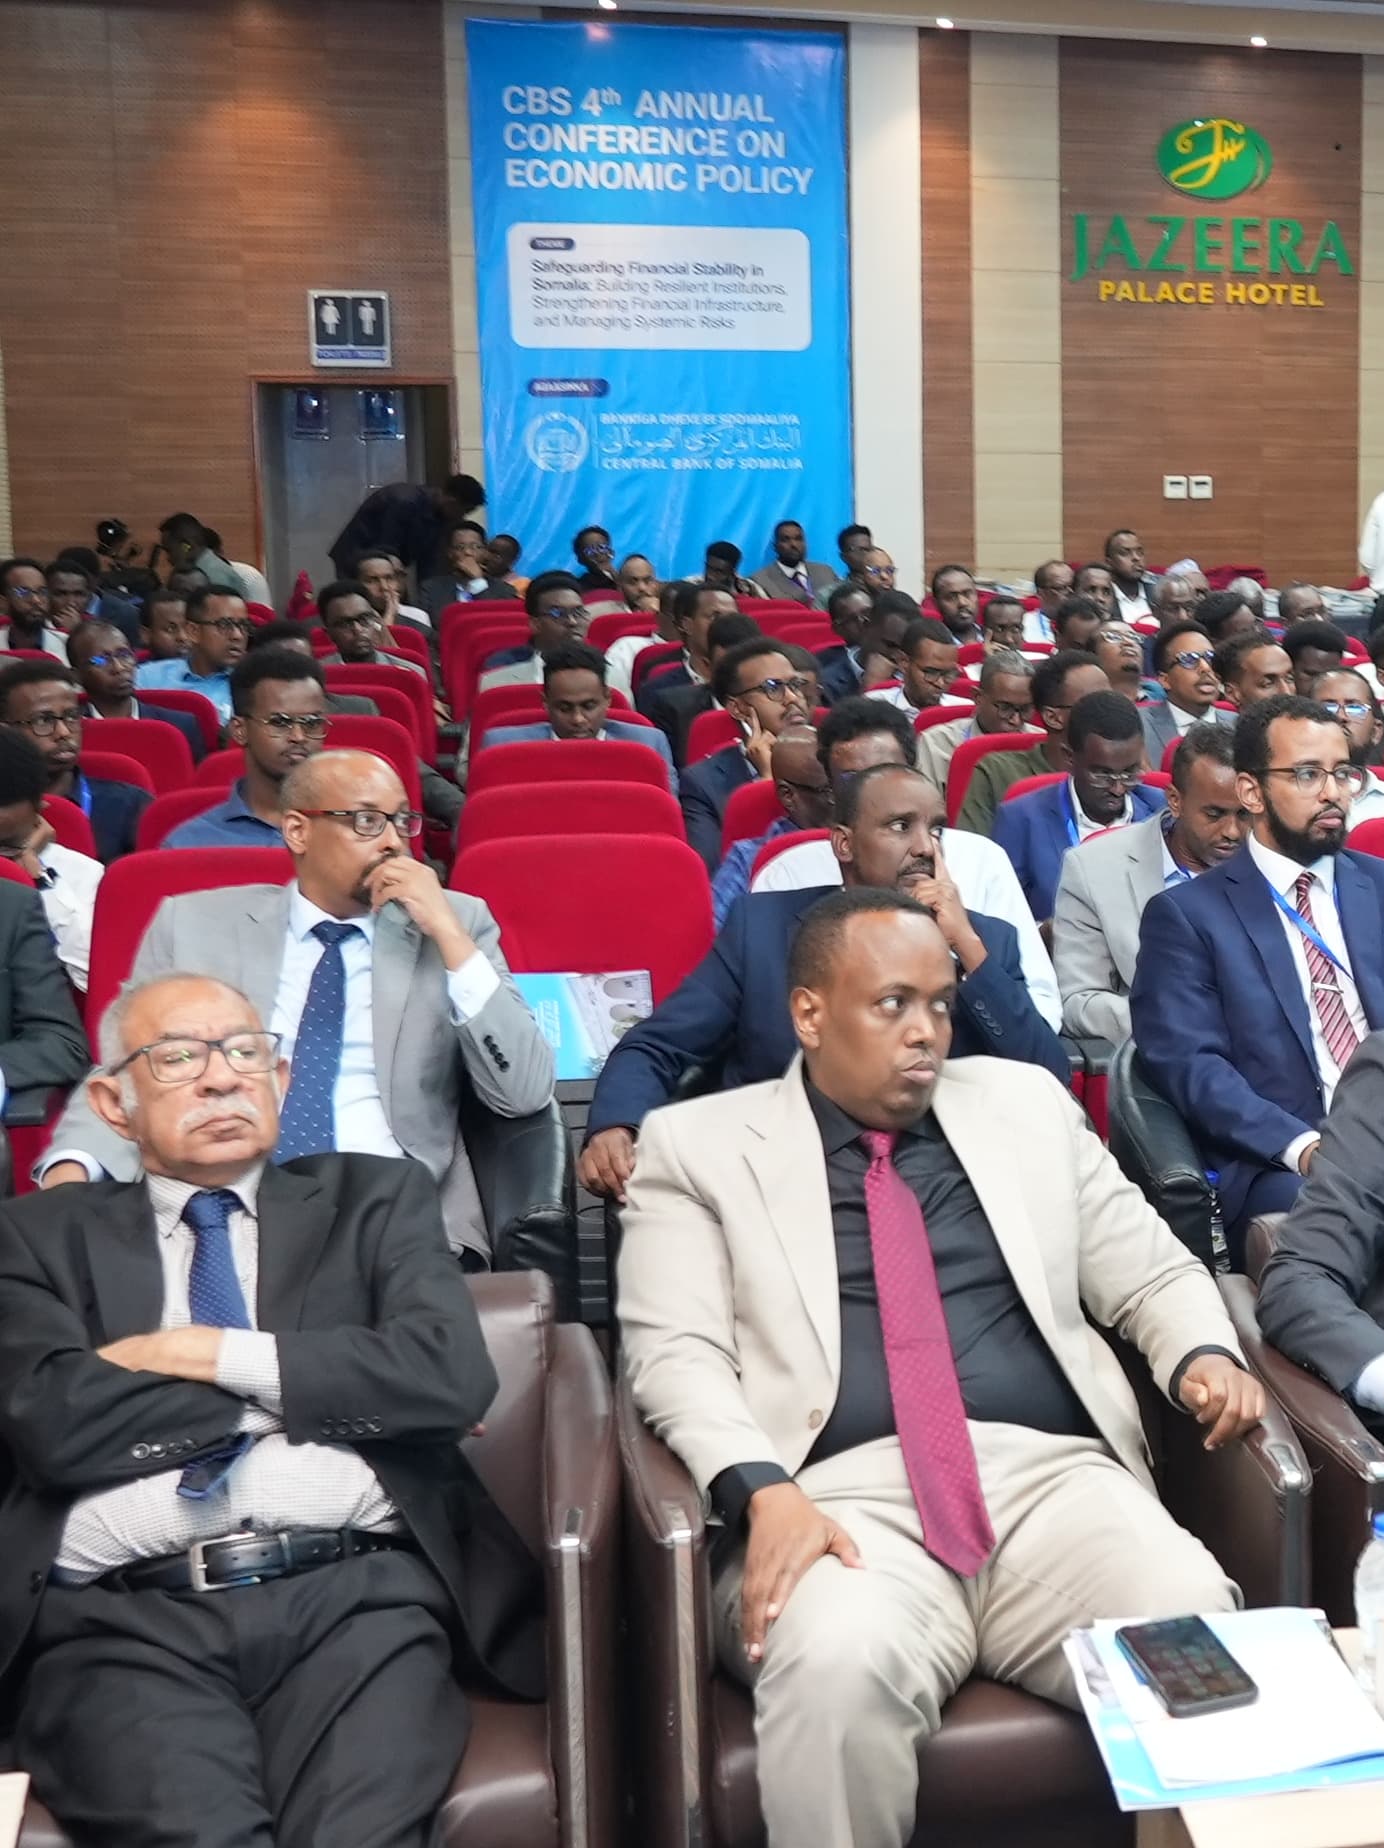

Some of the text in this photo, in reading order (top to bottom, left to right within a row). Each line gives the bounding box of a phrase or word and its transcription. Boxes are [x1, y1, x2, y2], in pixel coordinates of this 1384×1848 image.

[502, 85, 775, 124] CBS 4th ANNUAL
[503, 121, 786, 159] CONFERENCE ON
[505, 158, 815, 196] ECONOMIC POLICY
[1070, 213, 1354, 282] JAZEERA
[532, 259, 765, 279] Safeguarding Financial Stability in
[597, 278, 650, 296] Building
[654, 280, 710, 295] Resilient
[1099, 279, 1326, 307] PALACE HOTEL
[532, 295, 628, 313] Strengthening
[631, 297, 689, 312] Financial
[533, 314, 560, 328] and
[563, 314, 632, 331] Managing
[634, 314, 697, 331] Systemic
[601, 457, 803, 471] CENTRAL BANK OF SOMALIA
